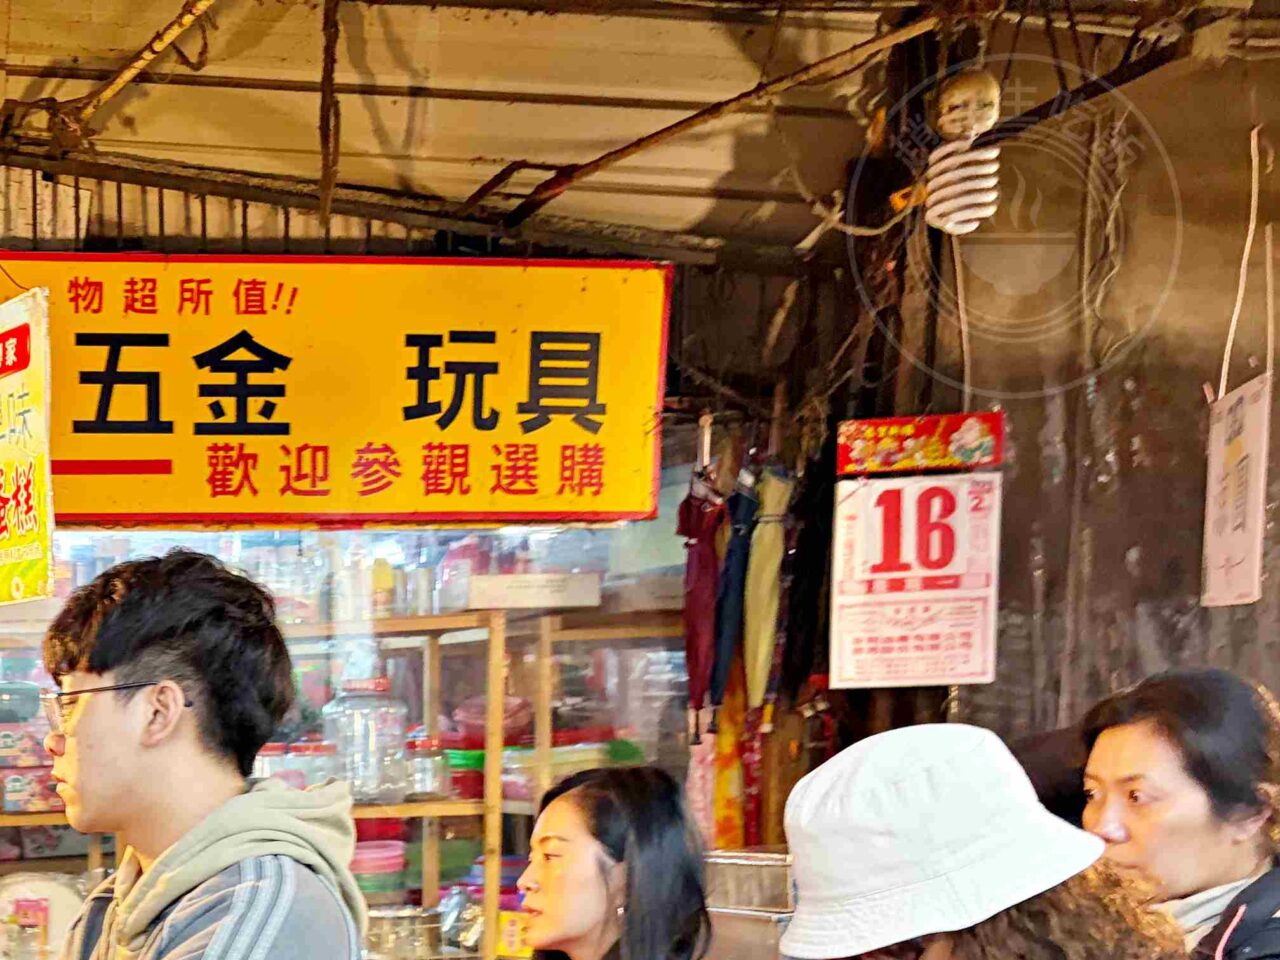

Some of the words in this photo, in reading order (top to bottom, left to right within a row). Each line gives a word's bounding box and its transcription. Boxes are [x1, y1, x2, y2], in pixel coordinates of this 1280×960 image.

[67, 275, 300, 317] 物超所值!!
[72, 329, 294, 437] 五金
[402, 330, 608, 434] 玩具
[206, 442, 606, 498] 歡迎參觀選購
[870, 486, 956, 573] 16
